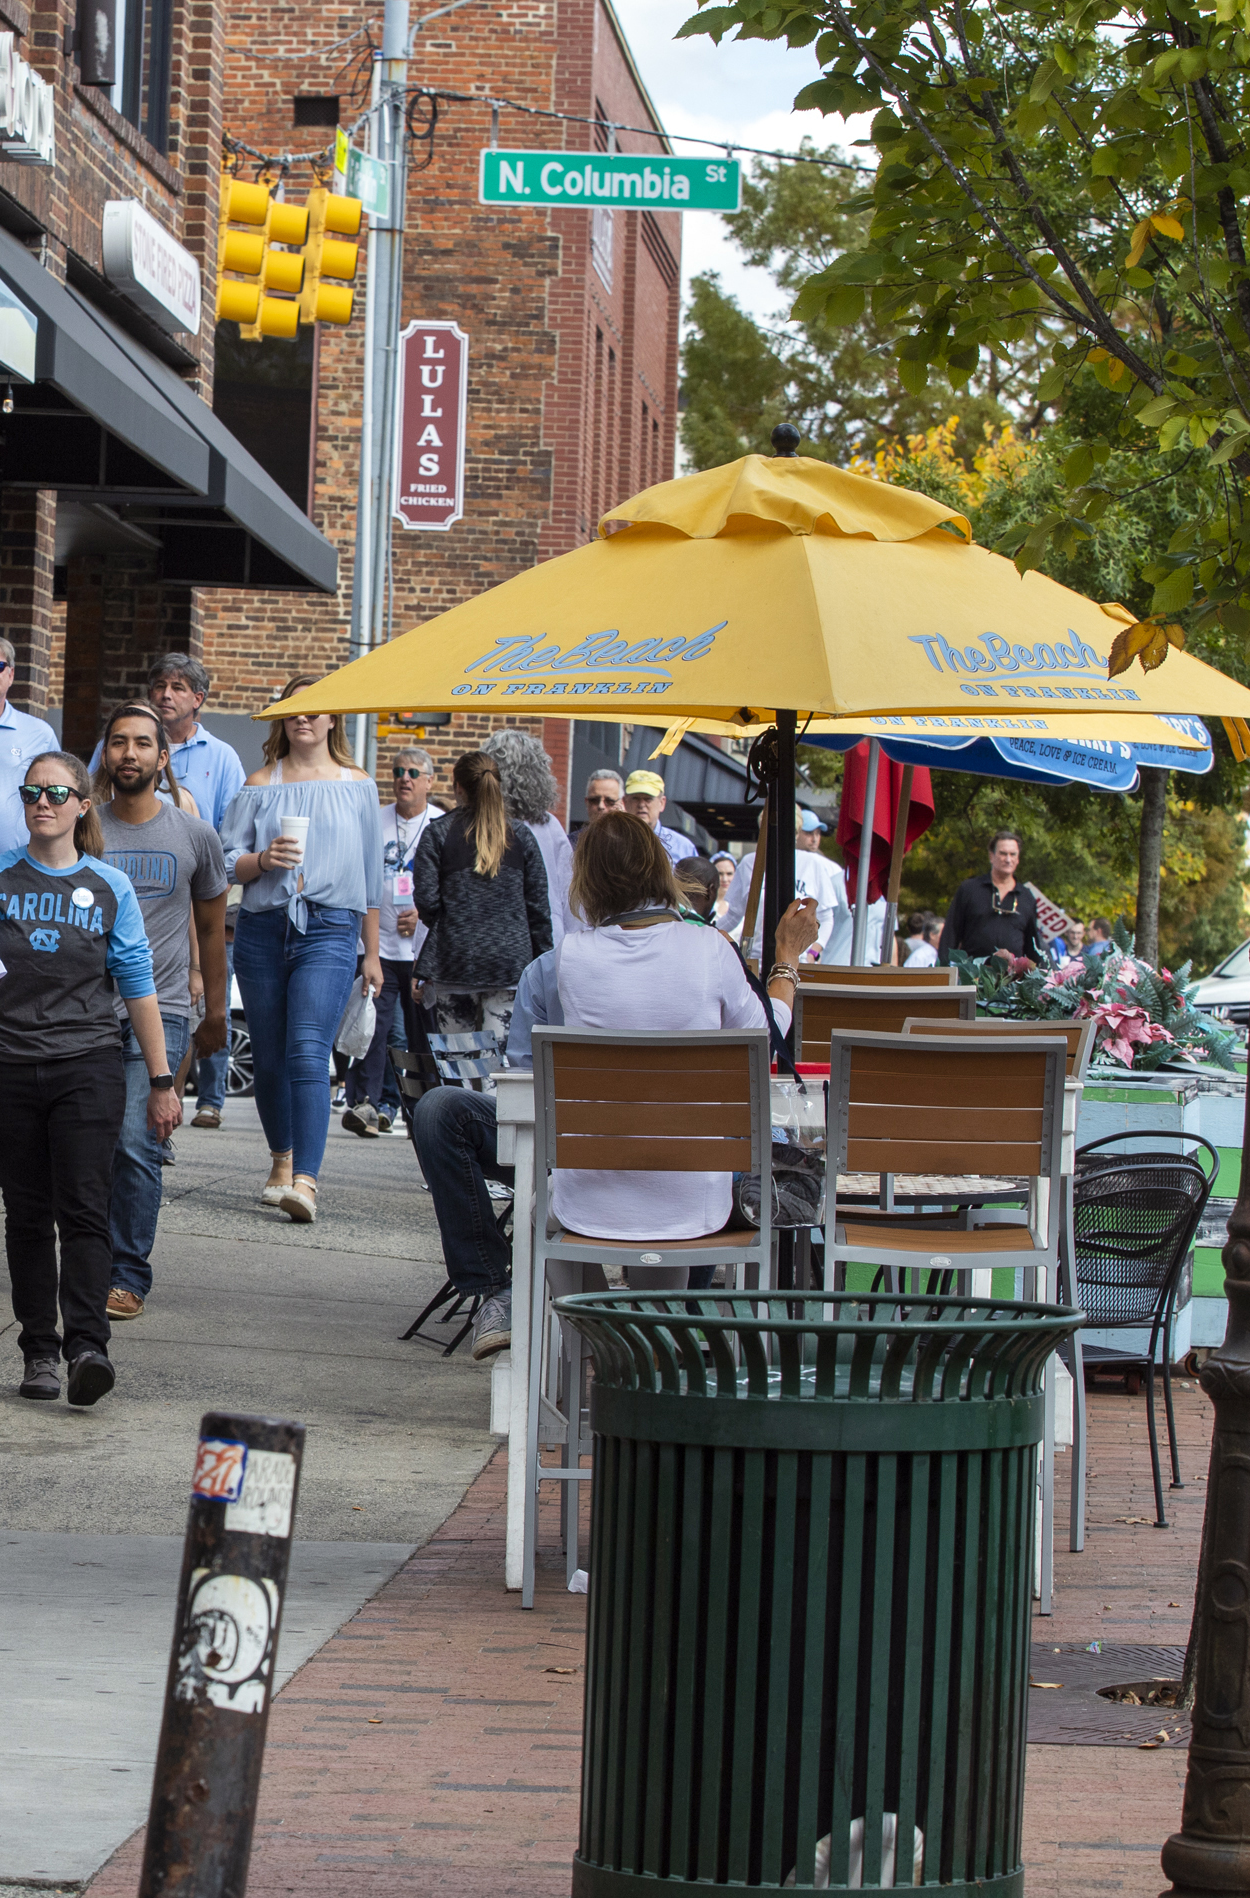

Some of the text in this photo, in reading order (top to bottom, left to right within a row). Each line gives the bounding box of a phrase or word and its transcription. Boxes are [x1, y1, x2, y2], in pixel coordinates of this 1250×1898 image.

[499, 160, 727, 200] N. Columbia St
[134, 219, 197, 317] STONE FIRED PIZZA
[417, 336, 446, 476] LULAS
[410, 483, 448, 493] FRIED
[400, 496, 455, 507] CHICKEN
[451, 682, 673, 696] ON FRANKLIN
[960, 684, 1142, 701] ON FRANKLIN
[870, 716, 1049, 730] ON FRANKLIN
[1009, 737, 1036, 756] PEACE,
[1039, 743, 1061, 760] LOVE
[1072, 752, 1086, 767] ICE
[1087, 756, 1118, 775] CREAM
